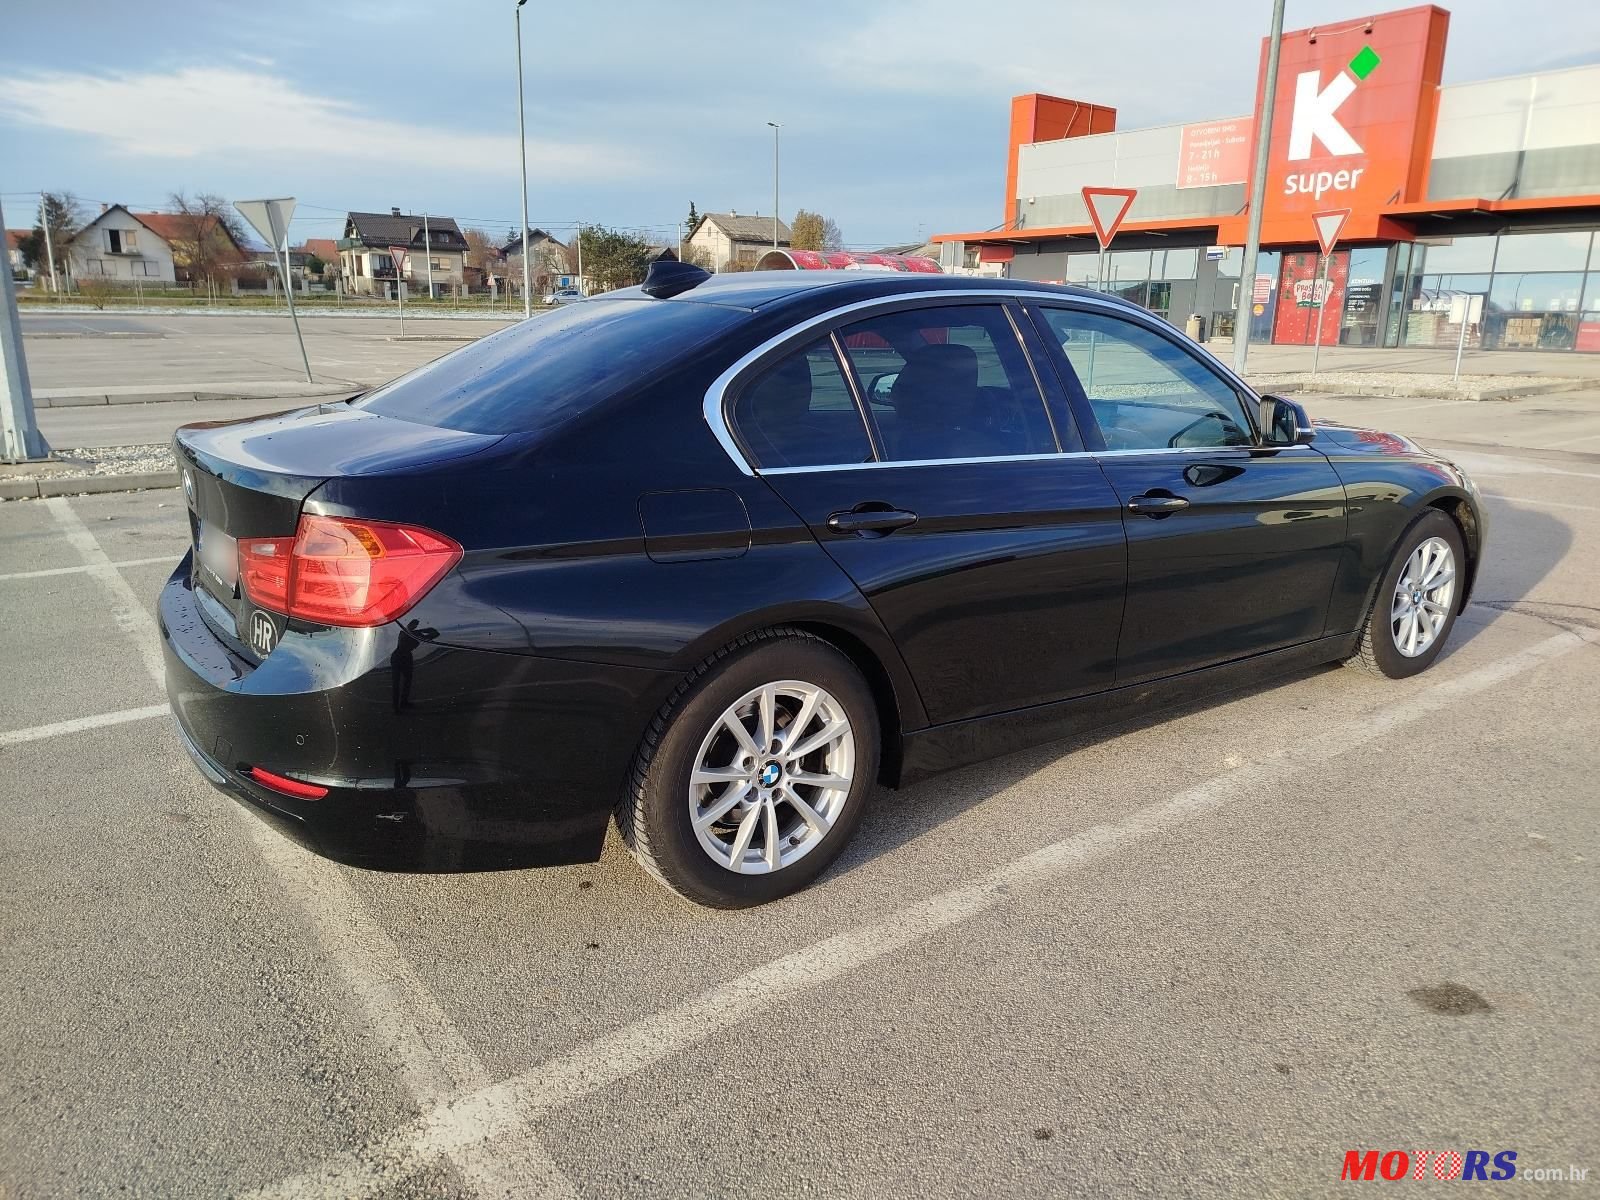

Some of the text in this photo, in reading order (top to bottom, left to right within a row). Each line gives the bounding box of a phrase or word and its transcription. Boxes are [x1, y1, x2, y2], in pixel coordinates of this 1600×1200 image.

[1288, 70, 1364, 161] K
[1201, 150, 1212, 160] 21
[1213, 148, 1220, 158] h
[1200, 172, 1210, 182] 15
[1284, 168, 1364, 201] super
[254, 615, 272, 653] HR
